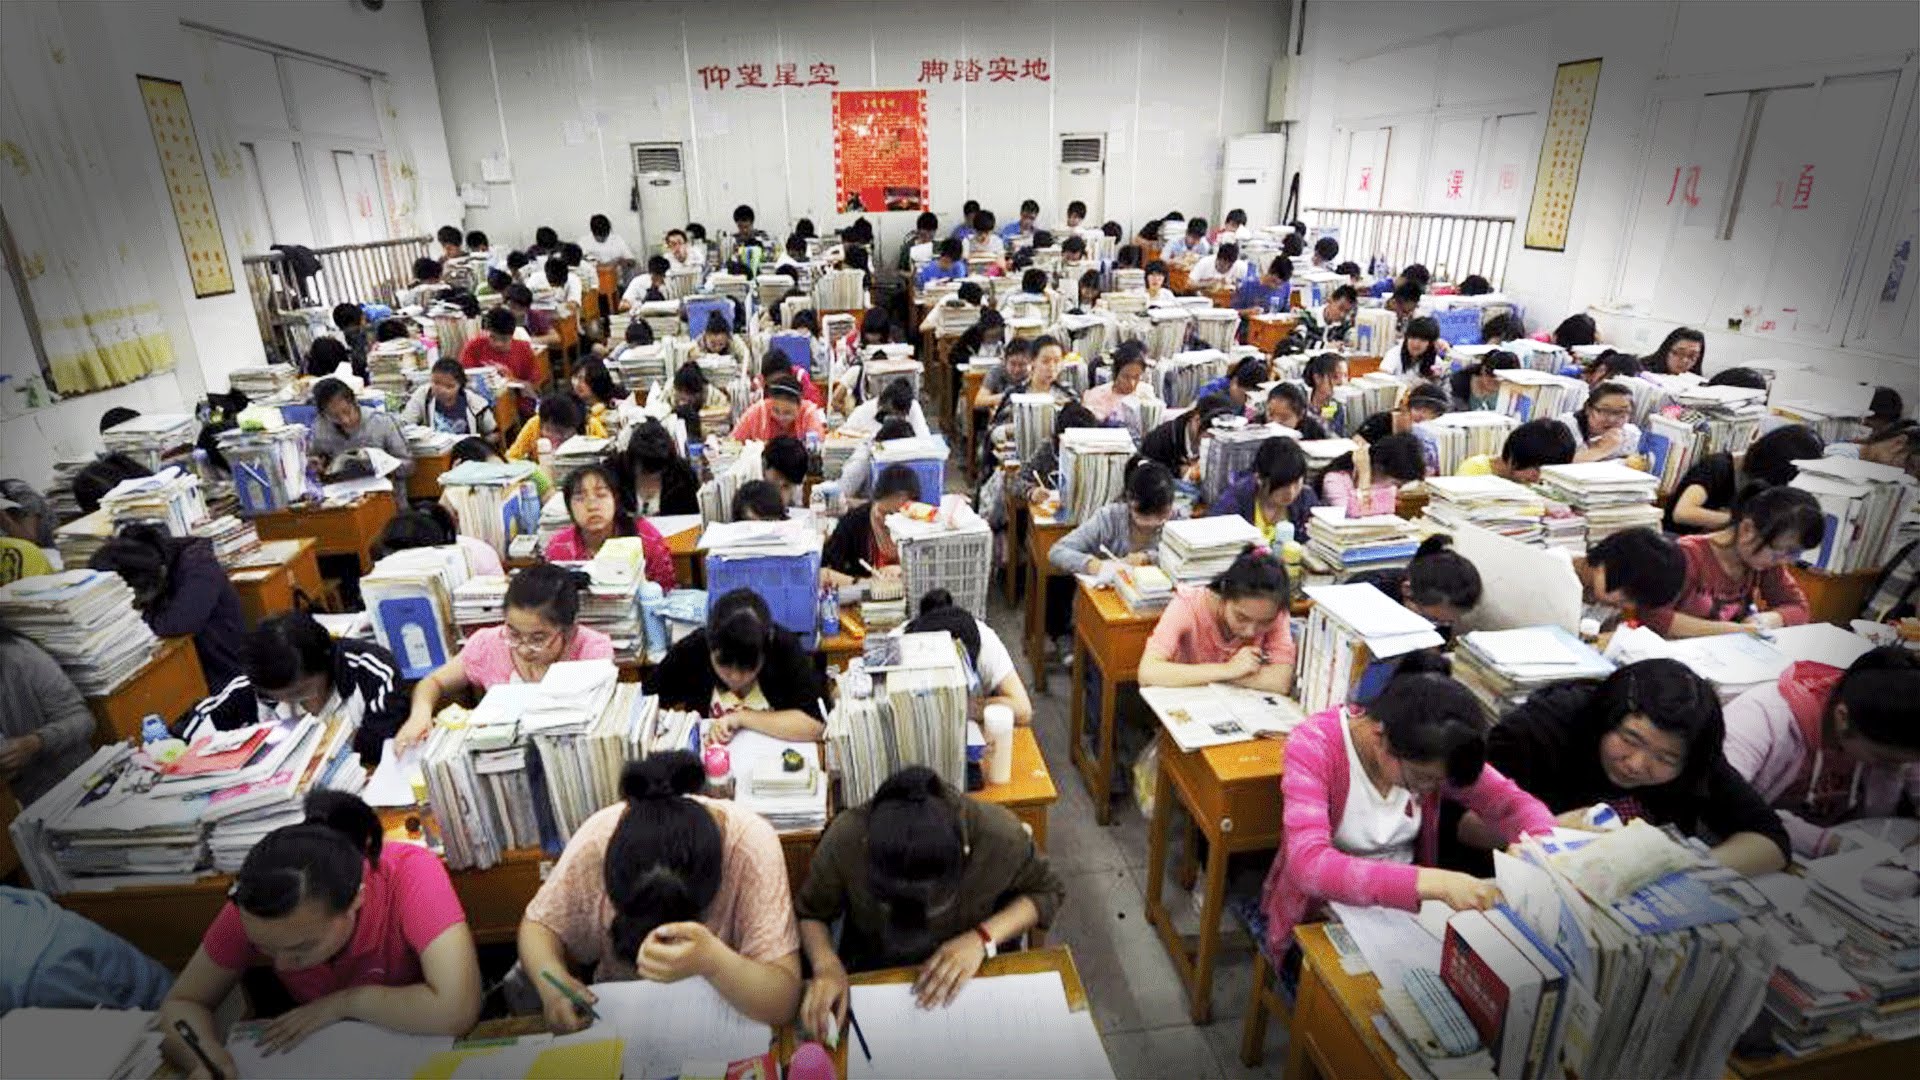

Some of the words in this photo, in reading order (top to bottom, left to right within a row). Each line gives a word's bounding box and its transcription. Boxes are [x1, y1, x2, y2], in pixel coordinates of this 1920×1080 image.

[698, 62, 839, 91] 仰望星空
[917, 56, 1051, 83] 脚踏实地
